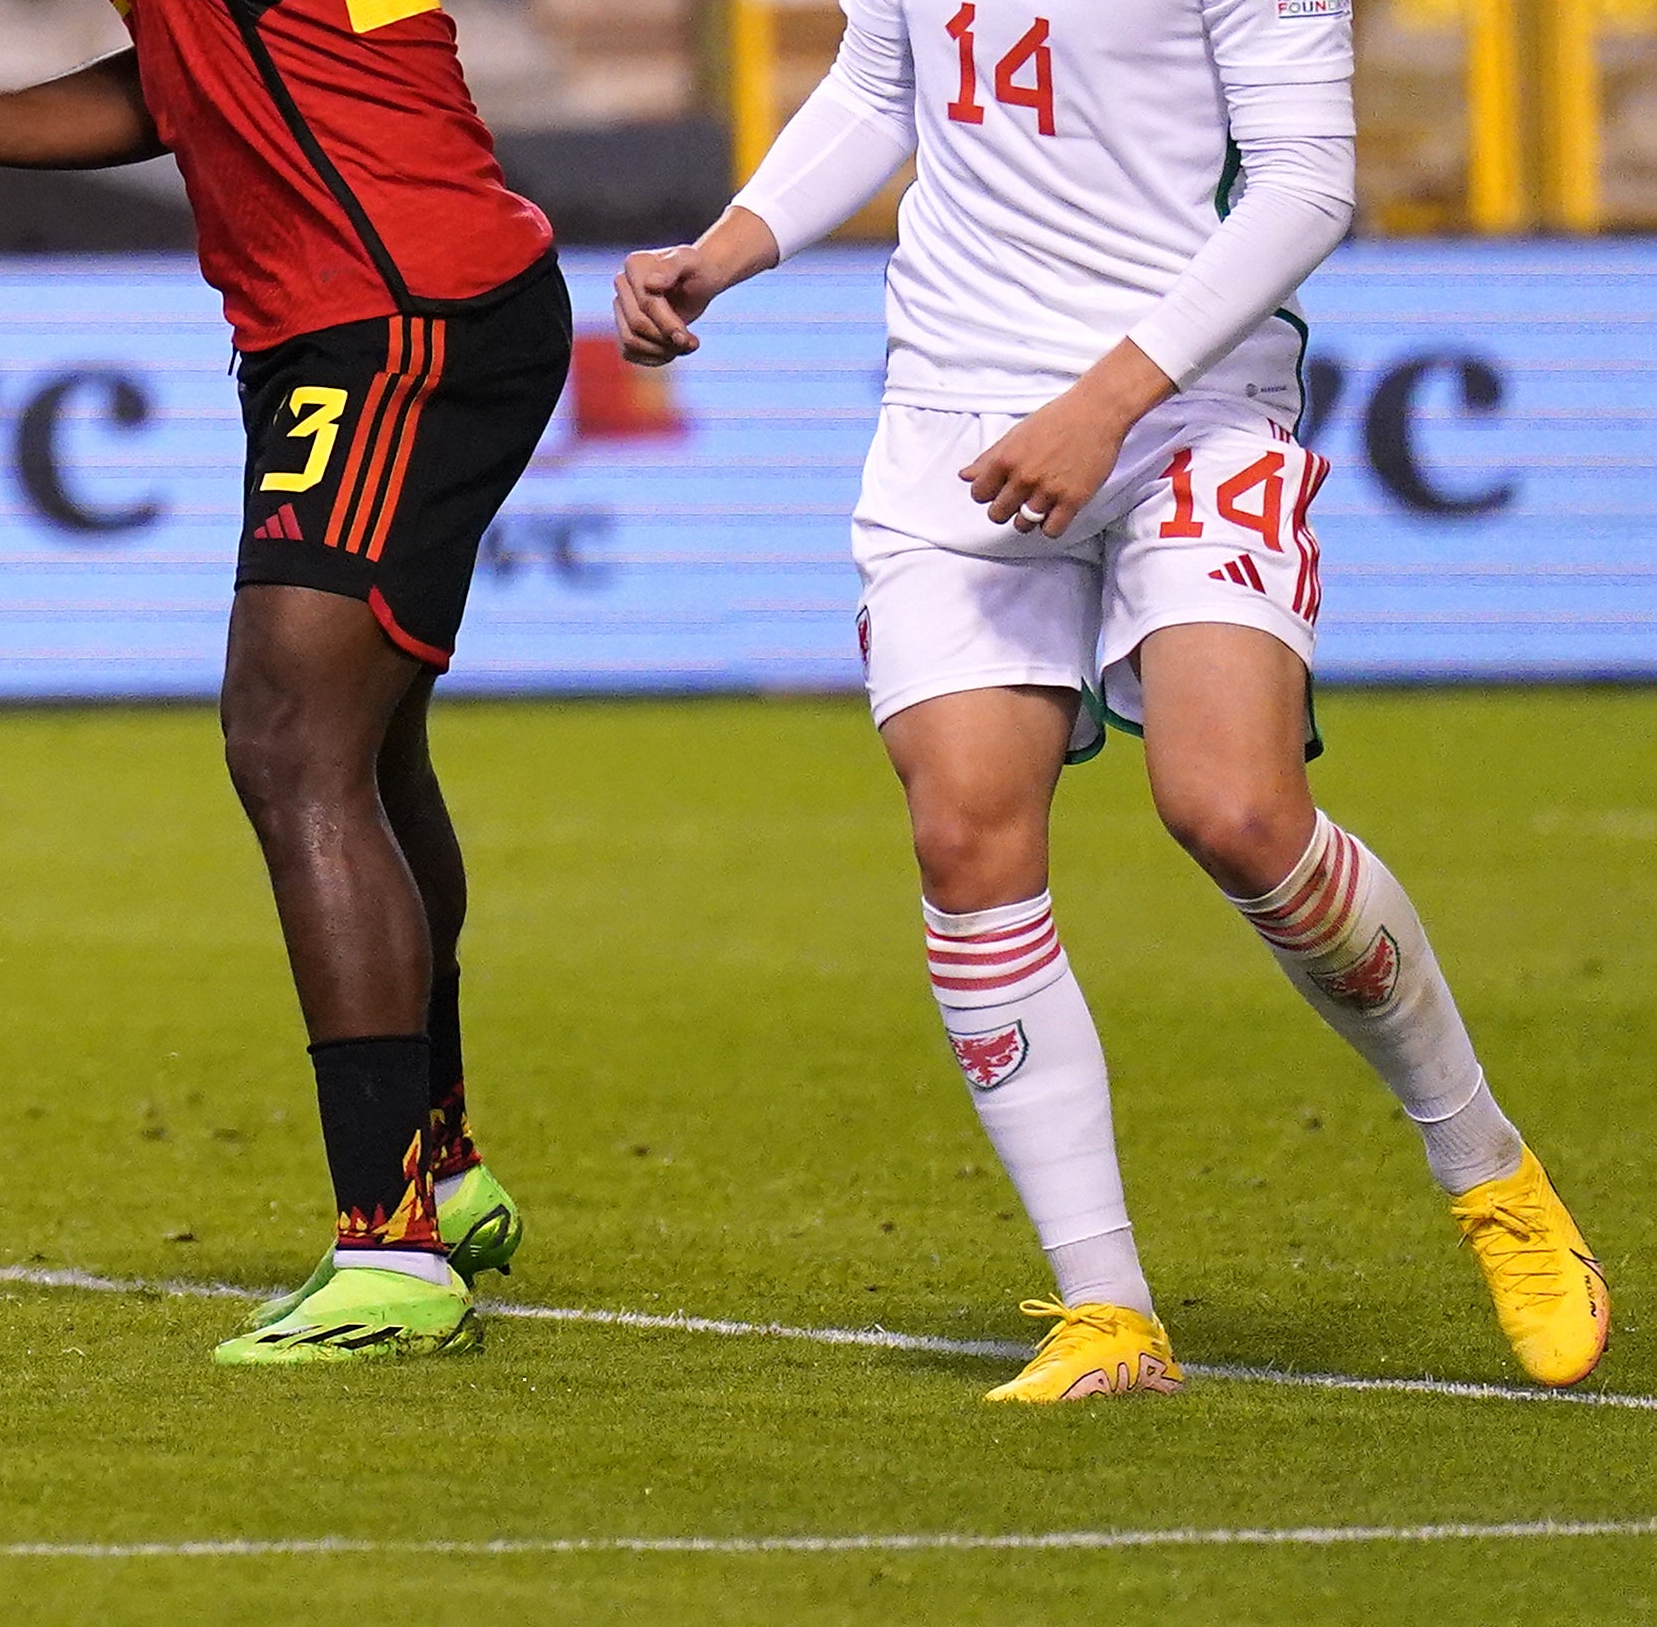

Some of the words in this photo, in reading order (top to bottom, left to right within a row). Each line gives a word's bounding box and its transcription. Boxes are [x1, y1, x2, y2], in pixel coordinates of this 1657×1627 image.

[945, 2, 1057, 137] 14
[256, 385, 349, 493] 3
[1158, 447, 1286, 553] 14
